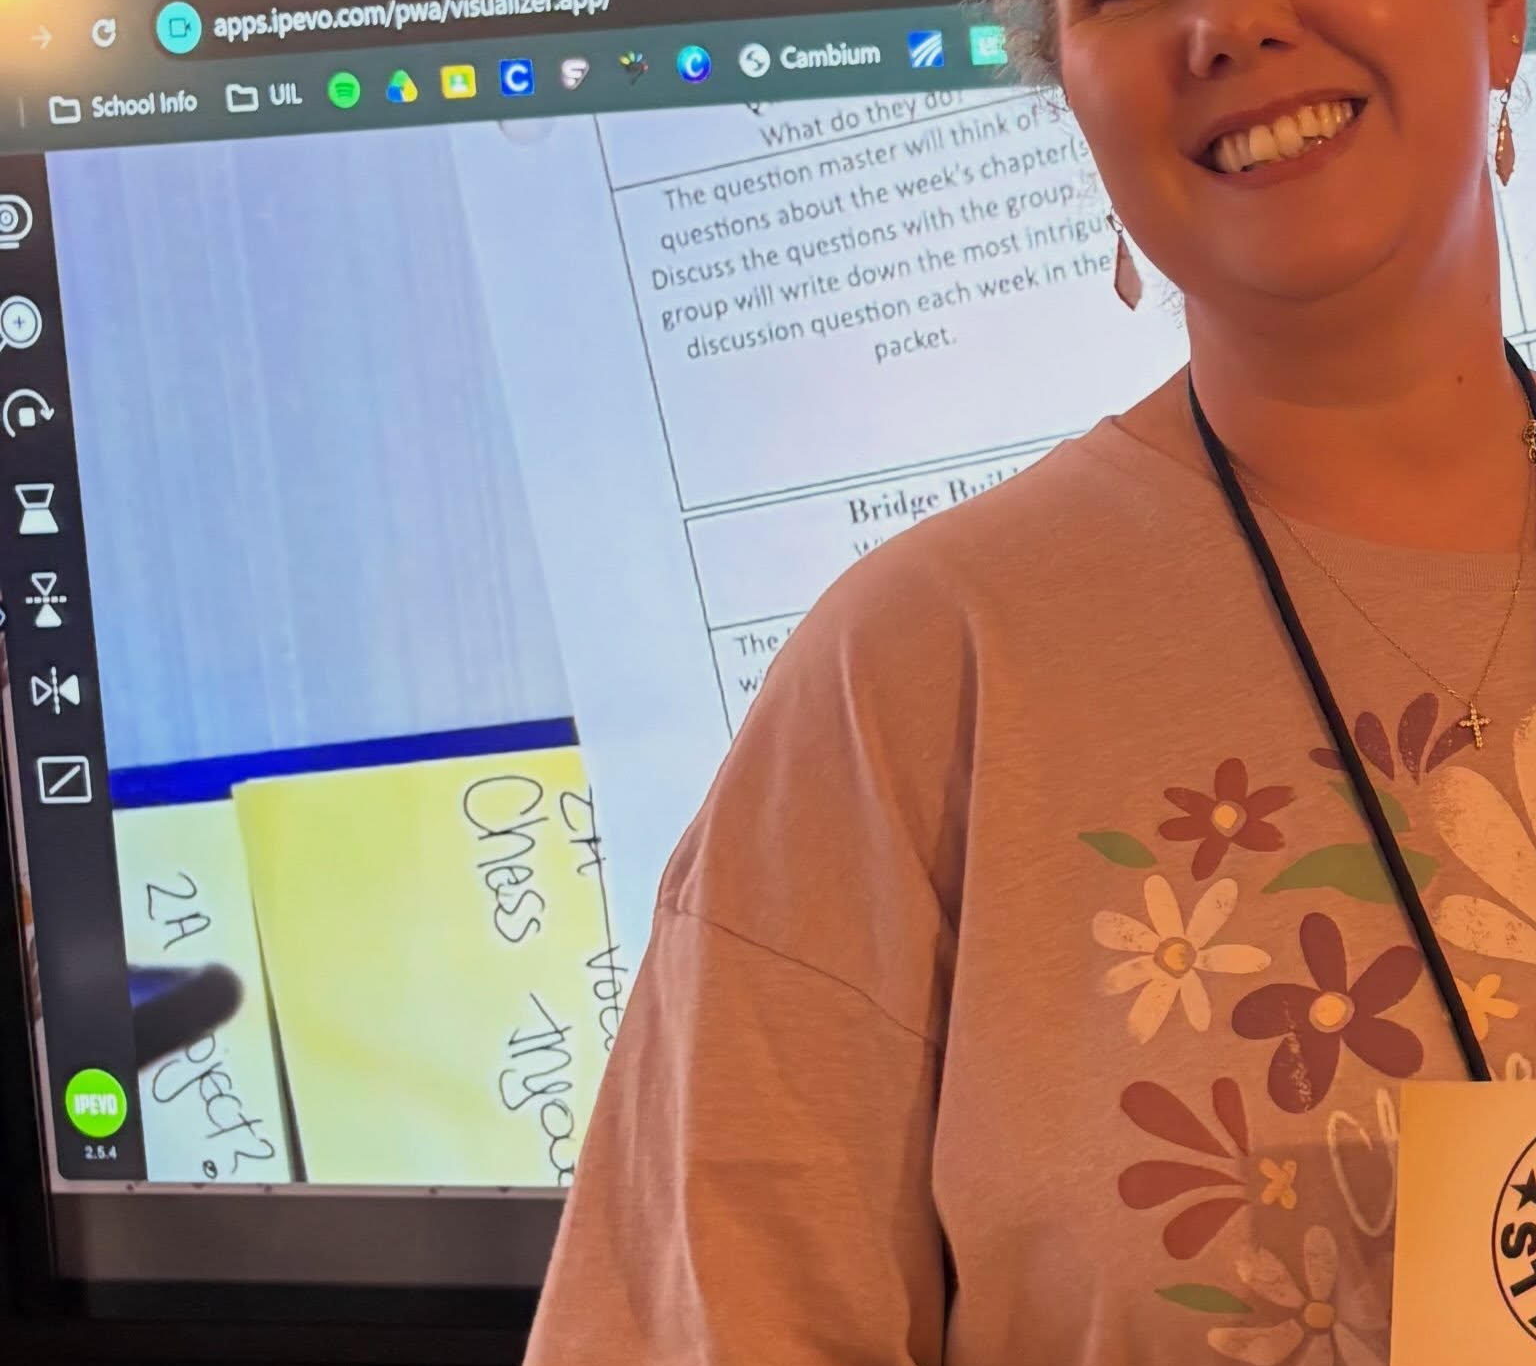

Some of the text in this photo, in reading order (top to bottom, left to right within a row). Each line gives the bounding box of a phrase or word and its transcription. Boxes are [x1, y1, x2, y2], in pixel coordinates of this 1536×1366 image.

[780, 42, 880, 69] Cambium
[92, 90, 197, 117] School Info
[269, 83, 302, 105] UIL
[759, 98, 917, 147] What they
[663, 118, 1009, 211] The question master will think
[660, 213, 771, 254] questions
[777, 195, 845, 225] about
[850, 184, 888, 209] the
[894, 162, 974, 199] week's
[651, 199, 998, 291] Discuss the questions with the
[661, 299, 728, 331] group
[733, 284, 773, 311] will
[779, 275, 840, 302] write
[847, 261, 910, 287] down
[917, 249, 955, 272] the
[962, 233, 1020, 263] most
[687, 253, 1111, 359] discussion question each week the
[874, 327, 956, 363] packet.
[849, 489, 940, 525] Bridge
[736, 635, 779, 668] The
[462, 775, 549, 943] Chess
[74, 1094, 118, 1115] IPEVO
